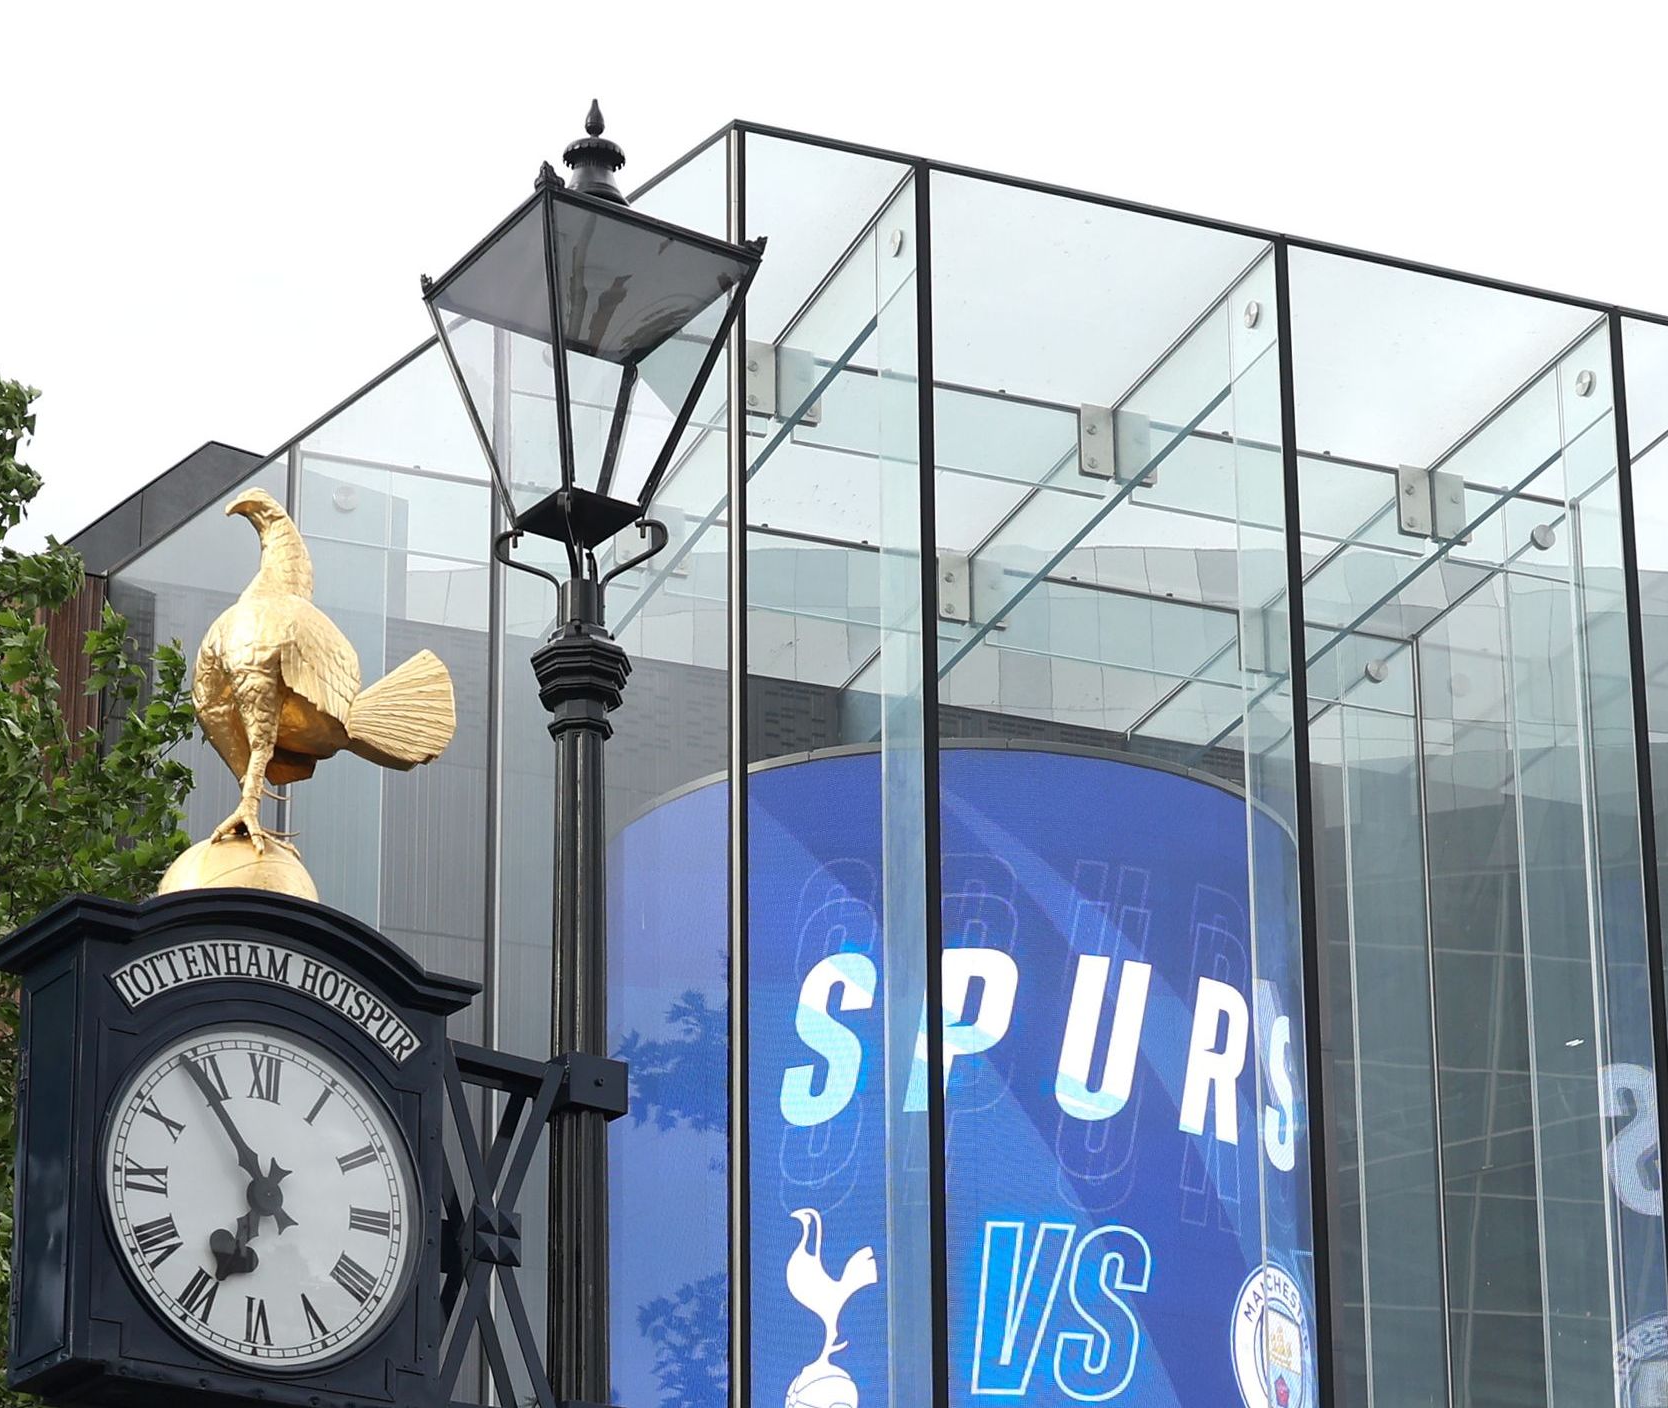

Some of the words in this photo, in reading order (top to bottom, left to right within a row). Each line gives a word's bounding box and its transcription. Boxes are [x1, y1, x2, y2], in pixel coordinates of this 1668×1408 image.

[112, 942, 293, 1005] TOTTENHAM
[298, 958, 416, 1063] HOTSPUR
[779, 947, 1296, 1172] SPURS
[246, 1052, 284, 1105] XII
[971, 1221, 1152, 1400] VS
[1244, 1274, 1309, 1350] MACHEST
